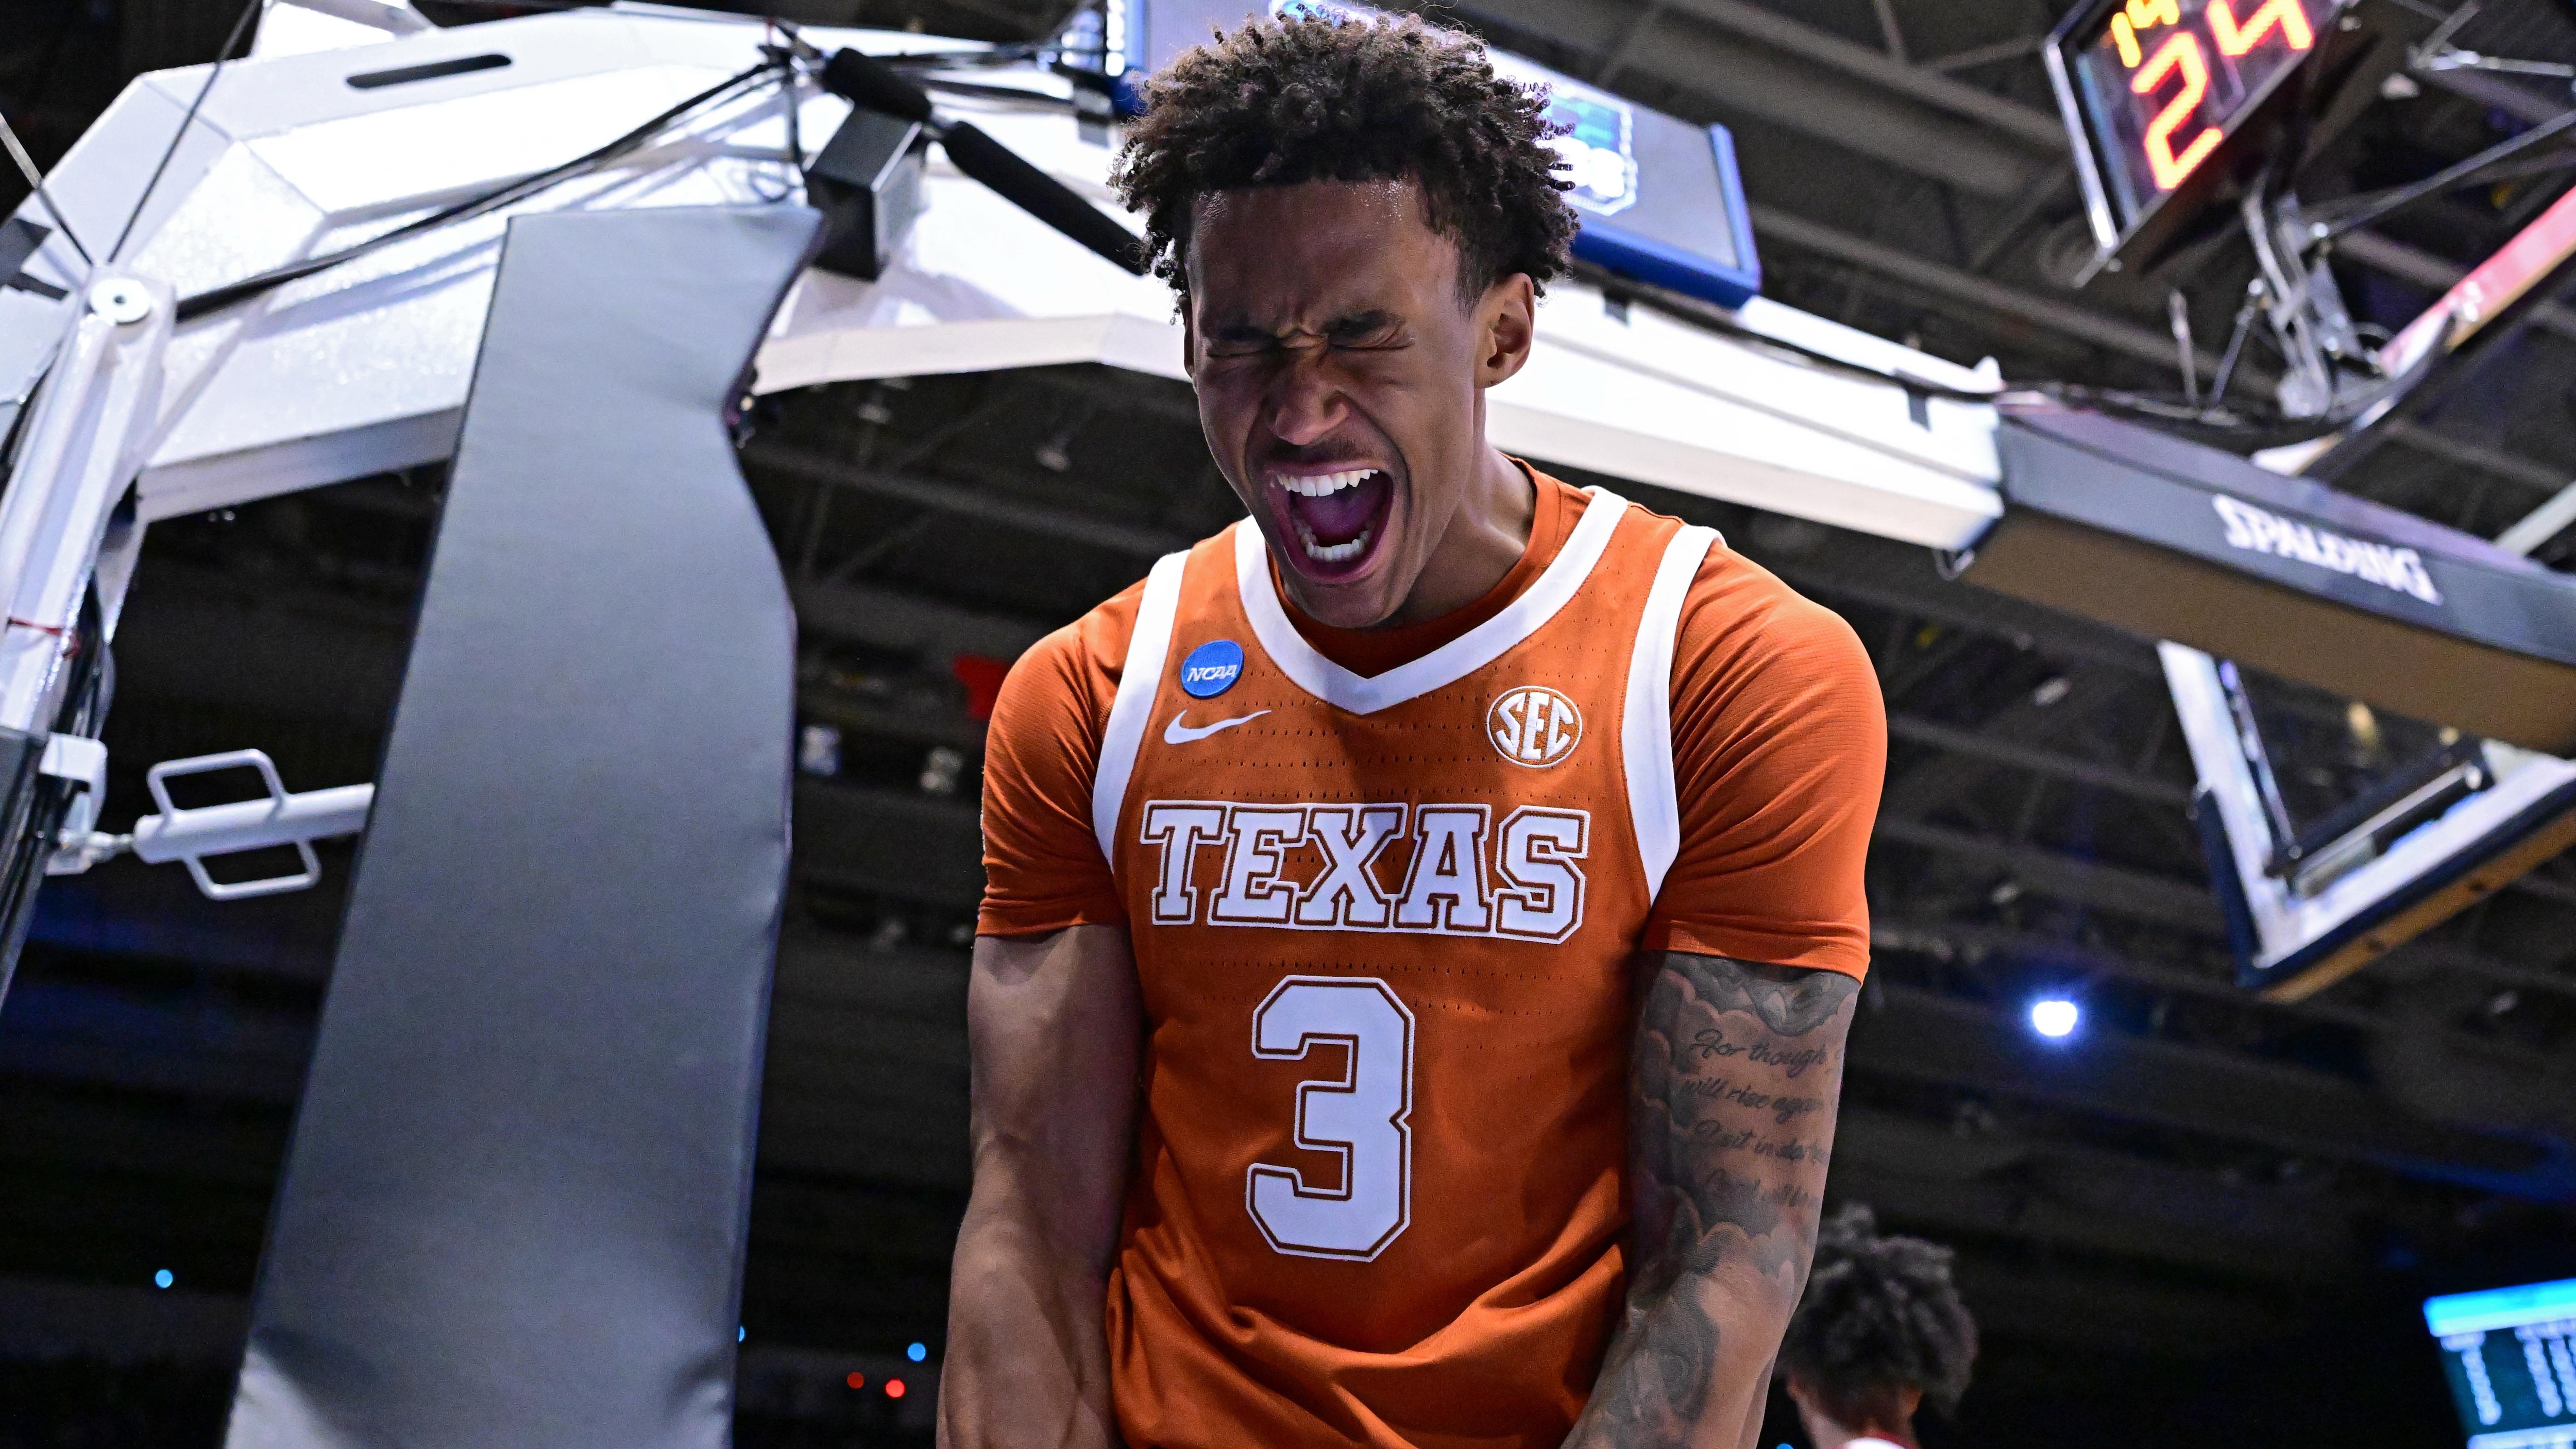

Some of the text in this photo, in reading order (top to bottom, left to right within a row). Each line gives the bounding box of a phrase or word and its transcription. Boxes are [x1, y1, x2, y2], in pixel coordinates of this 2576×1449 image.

[2131, 0, 2314, 190] 24
[2212, 493, 2444, 606] SPALDING
[1187, 664, 1238, 681] NCAA
[1495, 692, 1577, 760] SEC
[1140, 800, 1590, 944] TEXAS
[1688, 1029, 1747, 1059] For
[1748, 1039, 1828, 1079] though
[1246, 975, 1415, 1262] 3
